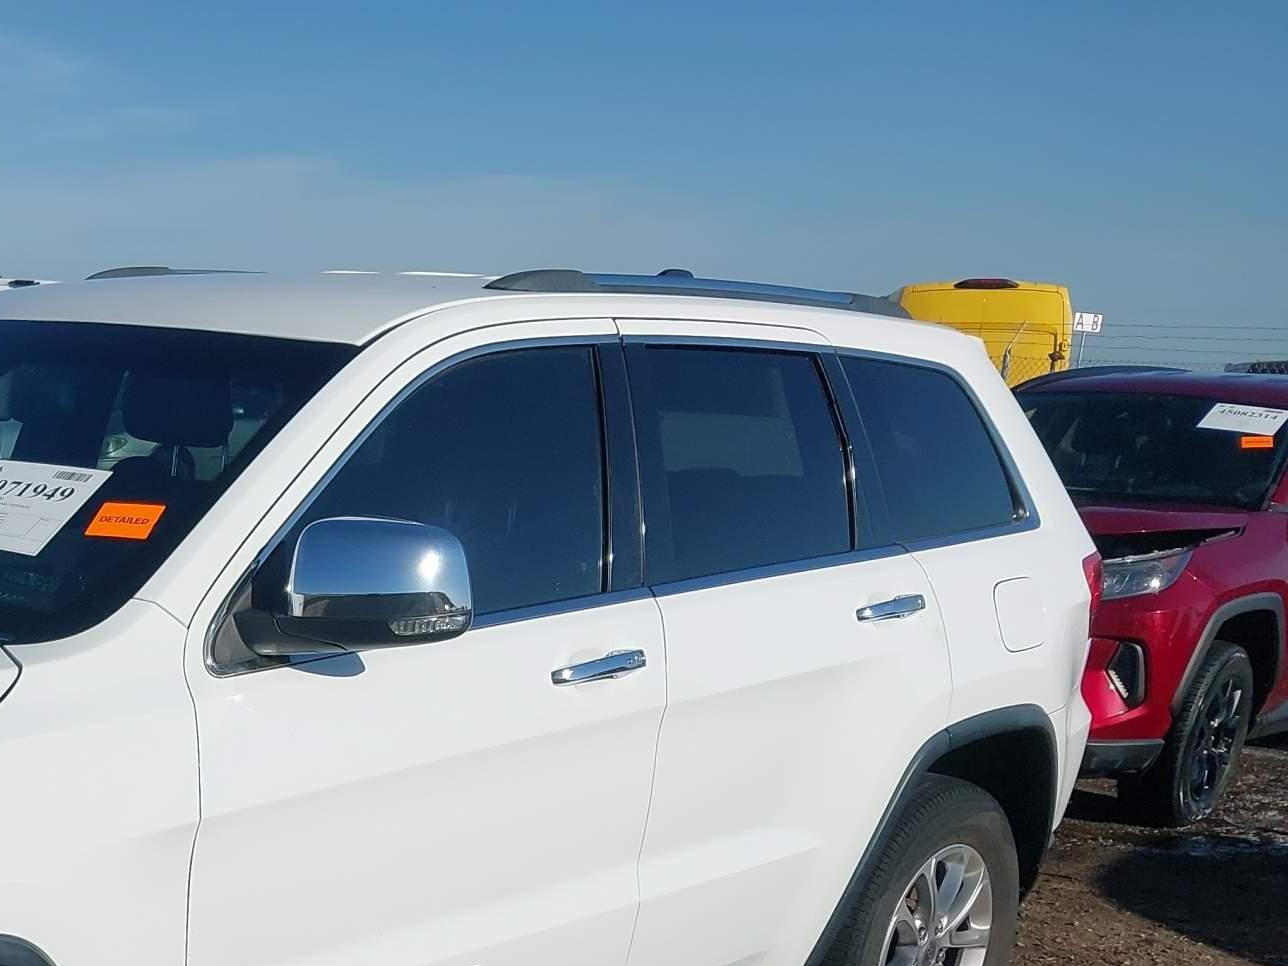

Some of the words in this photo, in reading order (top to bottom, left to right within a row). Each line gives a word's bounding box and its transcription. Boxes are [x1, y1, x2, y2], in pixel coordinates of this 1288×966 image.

[1075, 313, 1084, 330] A
[1091, 314, 1100, 331] B
[98, 515, 150, 525] DETAILED
